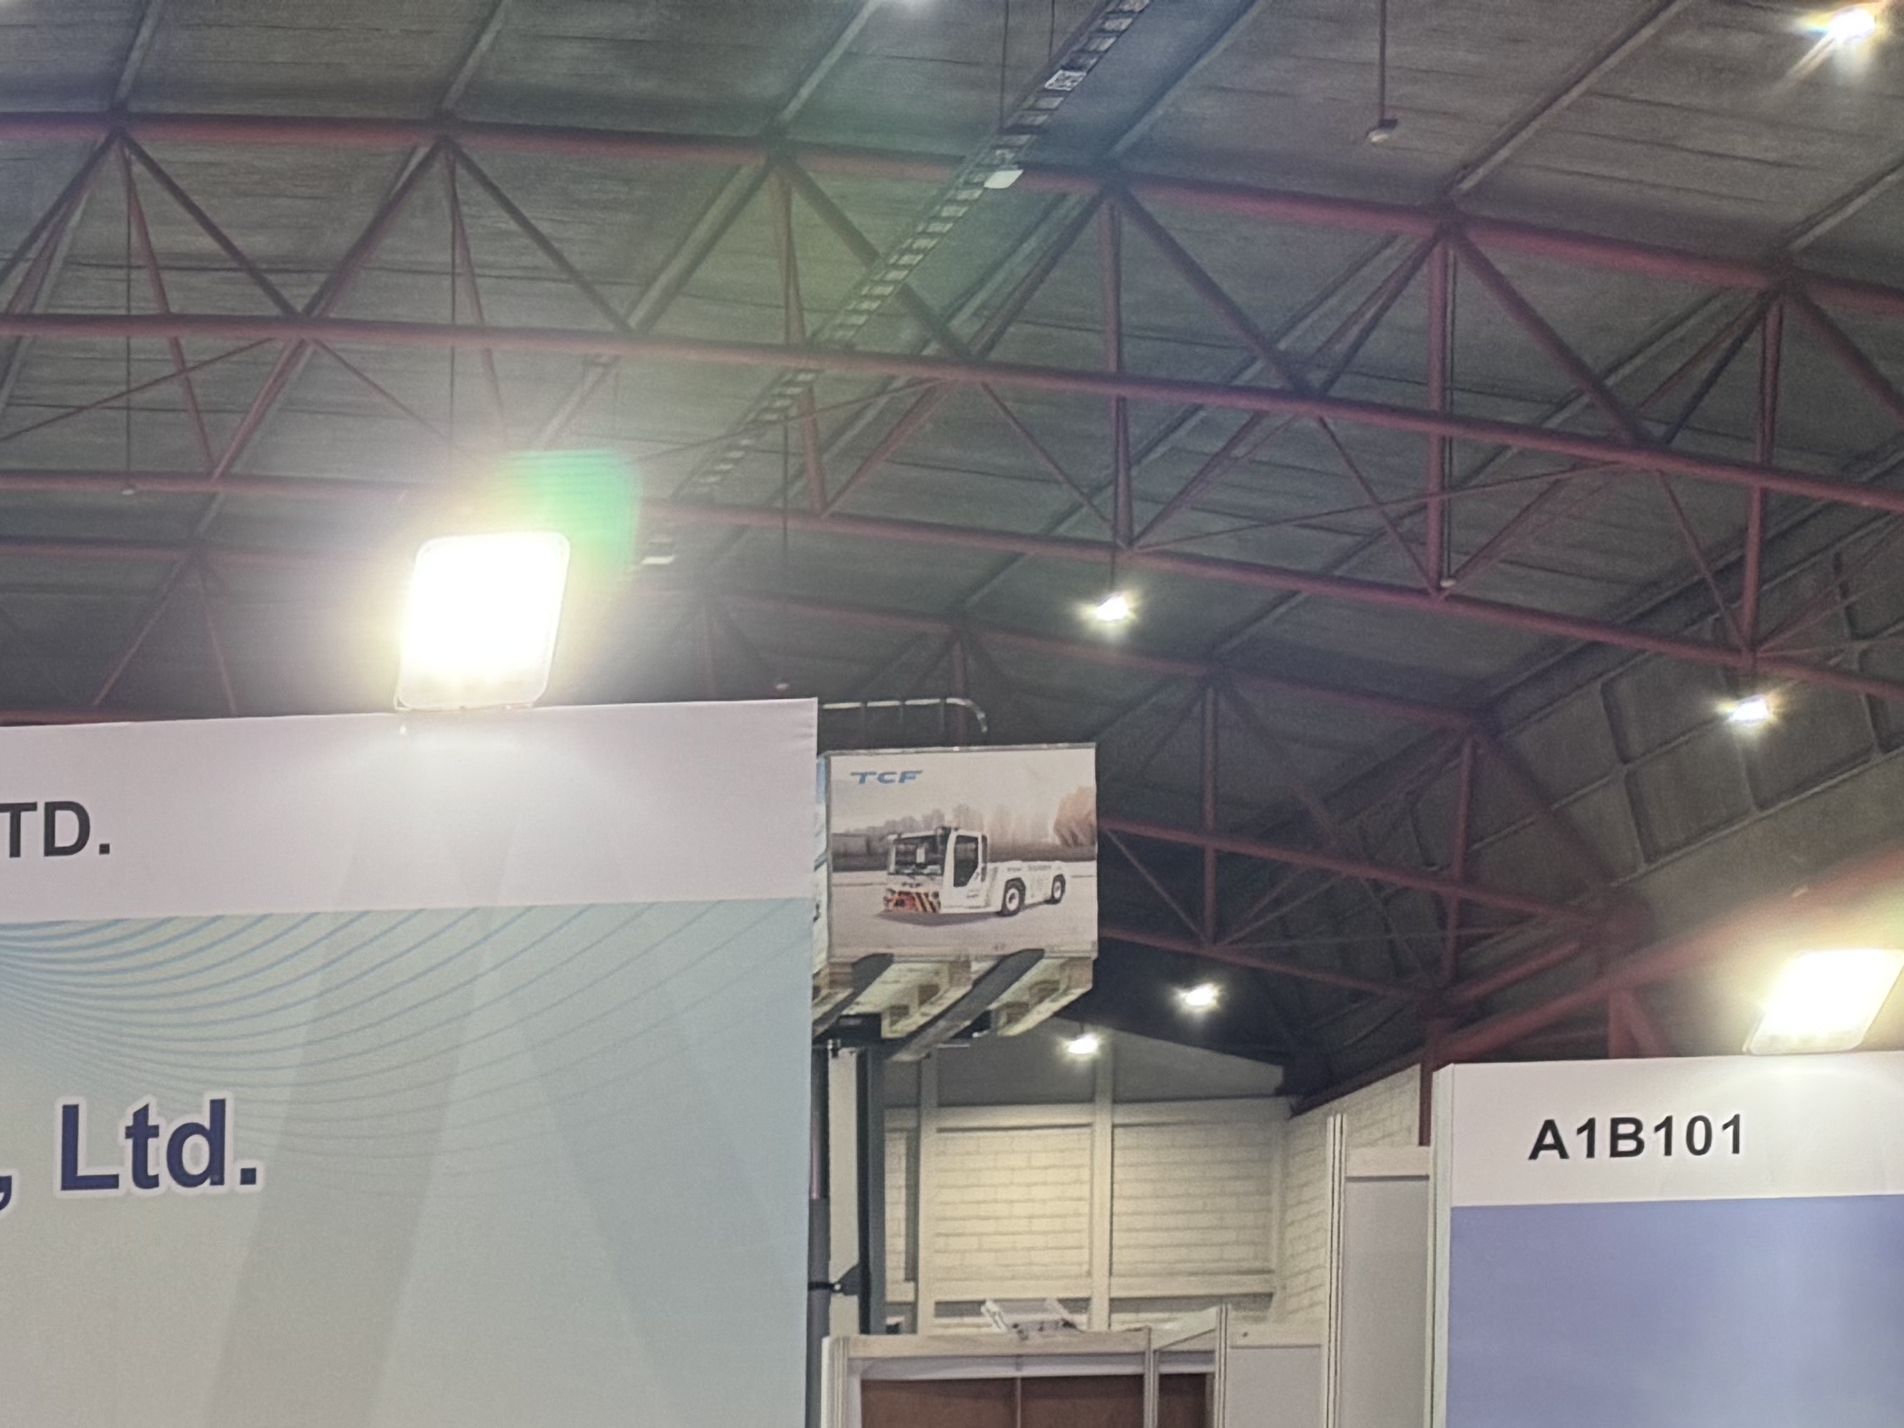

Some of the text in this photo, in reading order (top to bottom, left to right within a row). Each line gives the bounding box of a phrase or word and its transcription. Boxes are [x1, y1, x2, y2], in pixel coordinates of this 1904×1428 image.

[849, 769, 924, 785] TCF
[57, 1097, 260, 1193] Ltd.
[1527, 1113, 1742, 1161] A1B101
